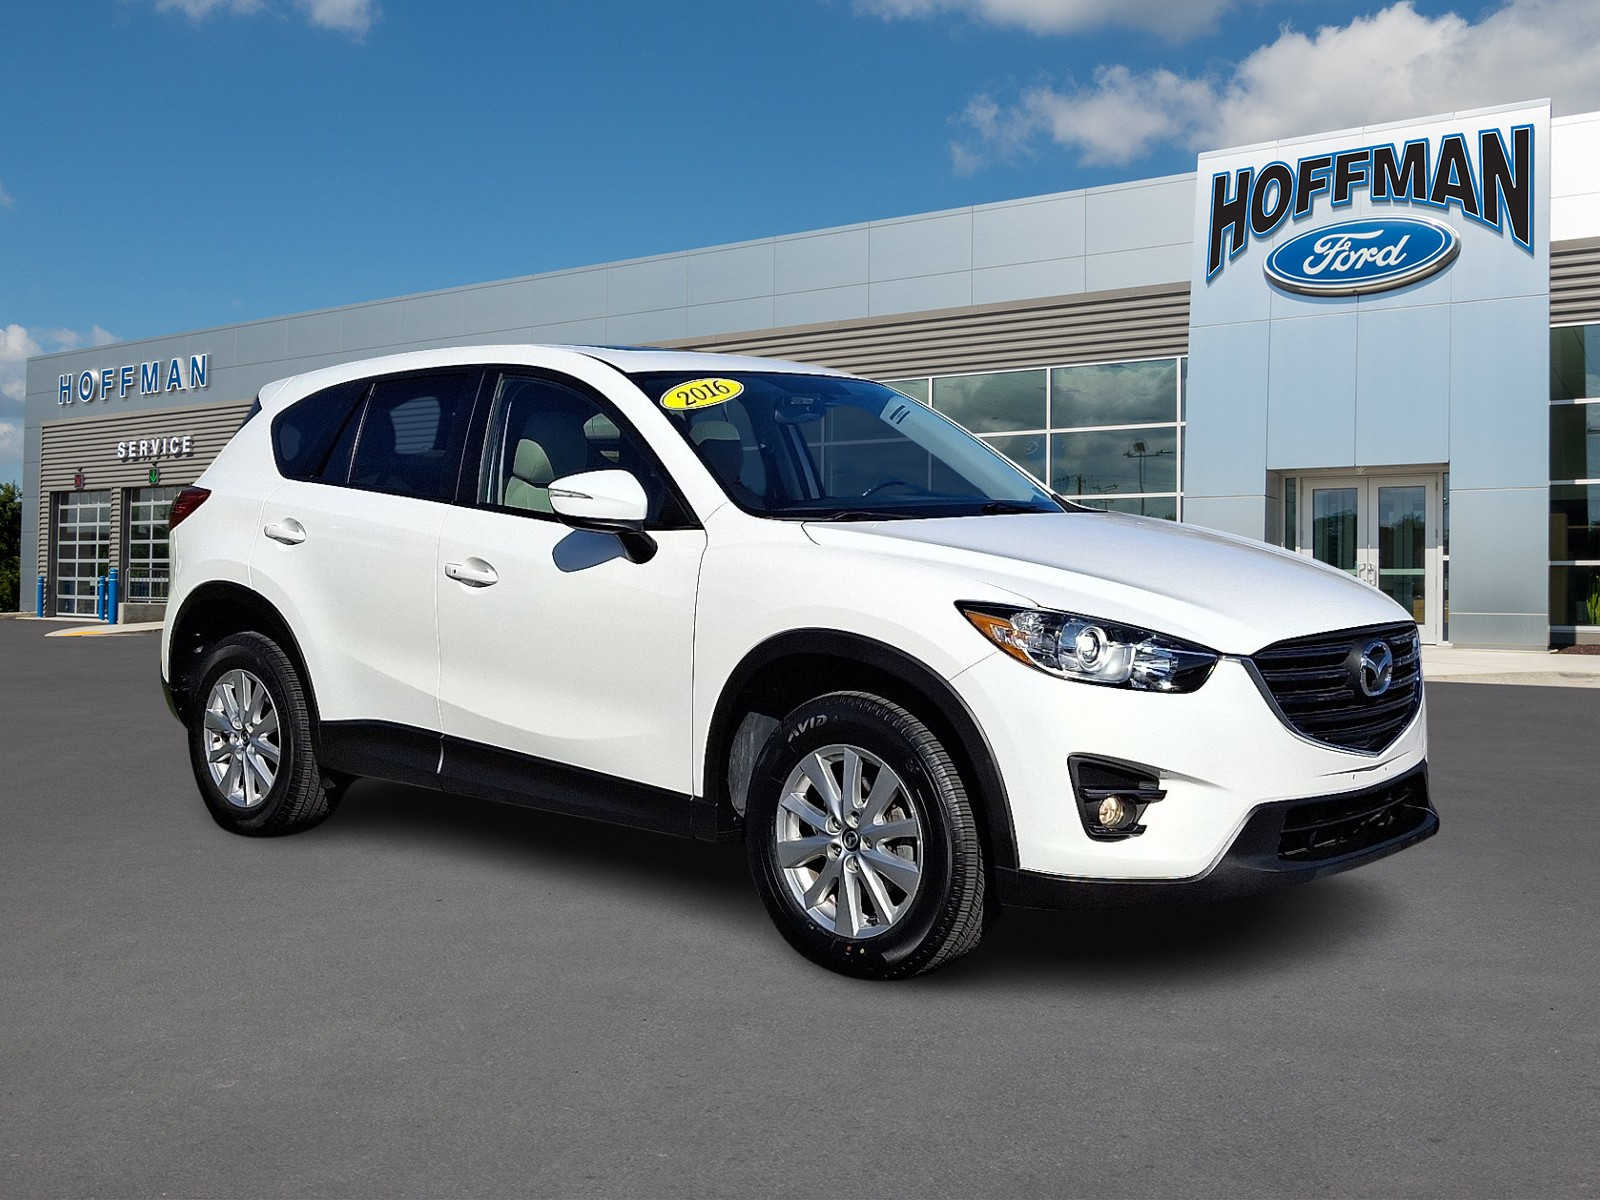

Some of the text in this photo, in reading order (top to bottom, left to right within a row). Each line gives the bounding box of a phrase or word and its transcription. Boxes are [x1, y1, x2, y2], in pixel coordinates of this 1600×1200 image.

[1207, 123, 1534, 282] HOFFMAN
[1303, 229, 1408, 273] Ford
[58, 354, 208, 405] HOFFMAN
[677, 380, 730, 405] 2016
[117, 436, 192, 458] SERVICE
